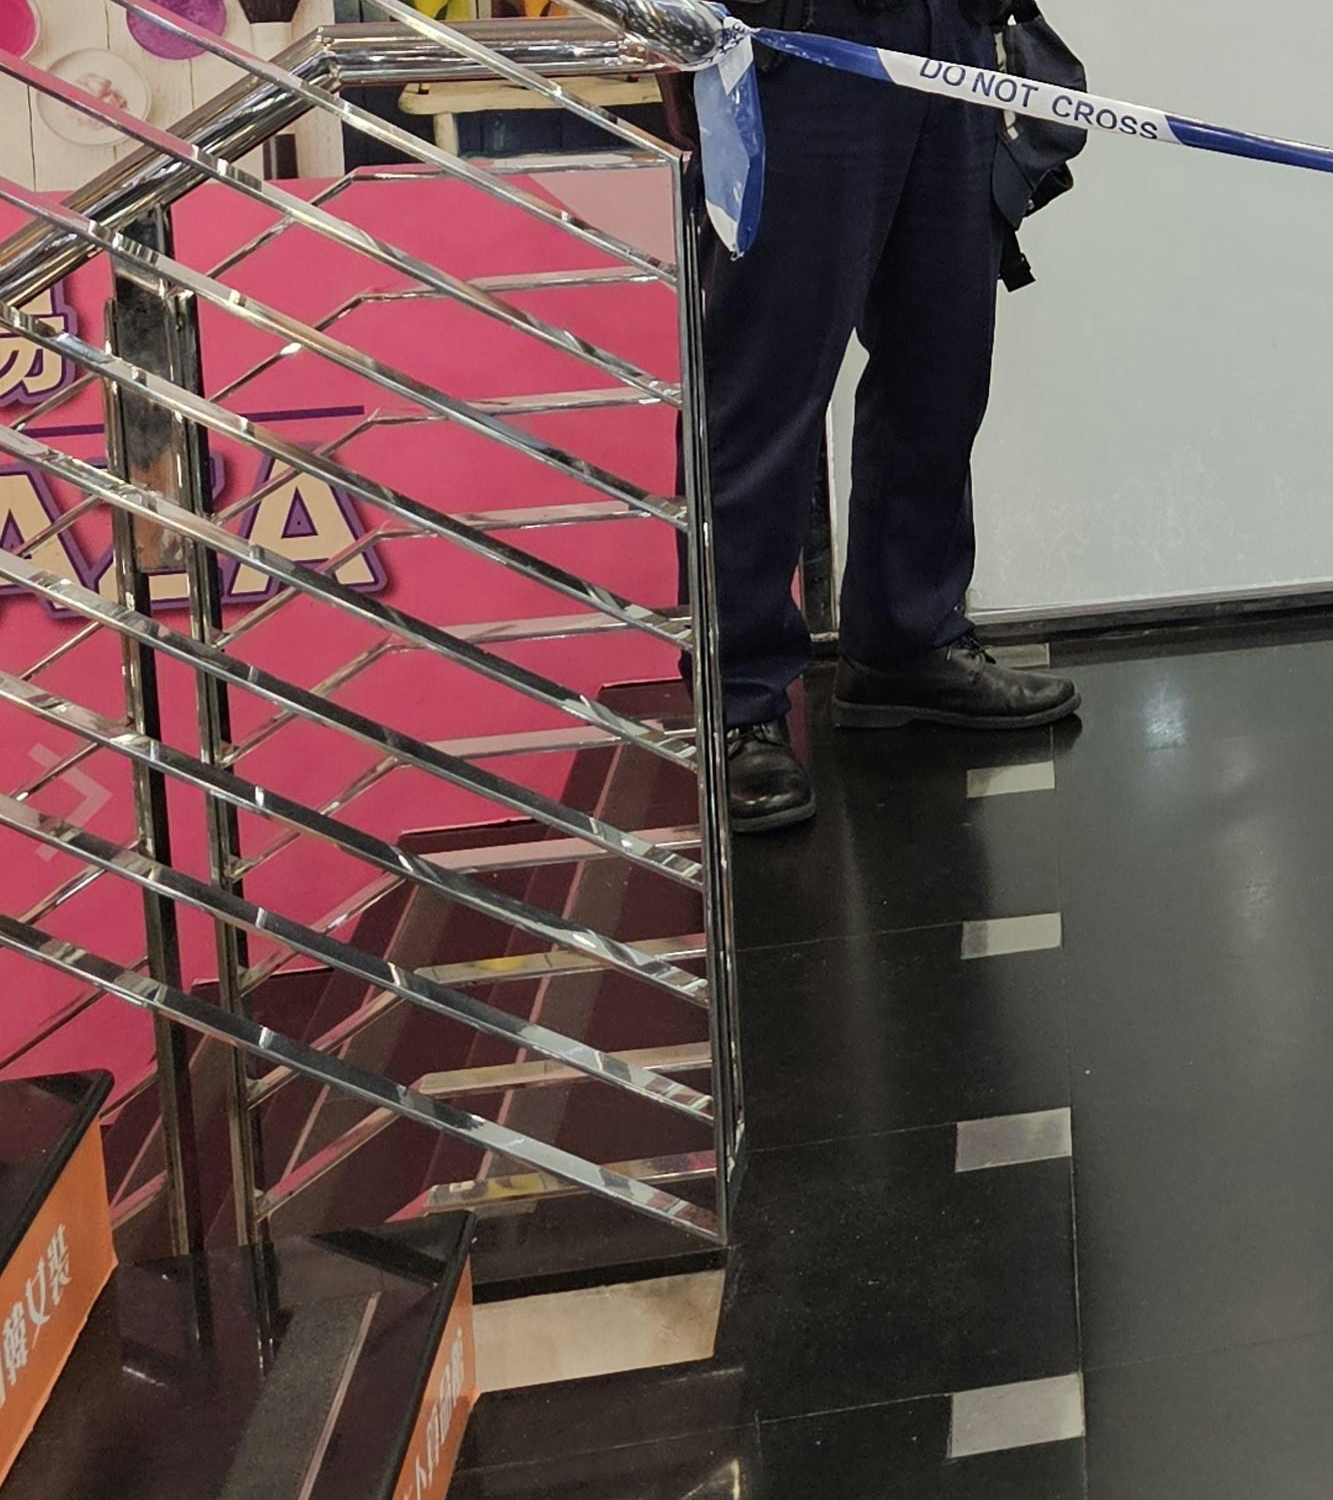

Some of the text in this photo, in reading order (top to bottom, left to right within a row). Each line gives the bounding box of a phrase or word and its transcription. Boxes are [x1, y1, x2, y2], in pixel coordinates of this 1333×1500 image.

[919, 58, 1159, 141] DO NOT CROSS
